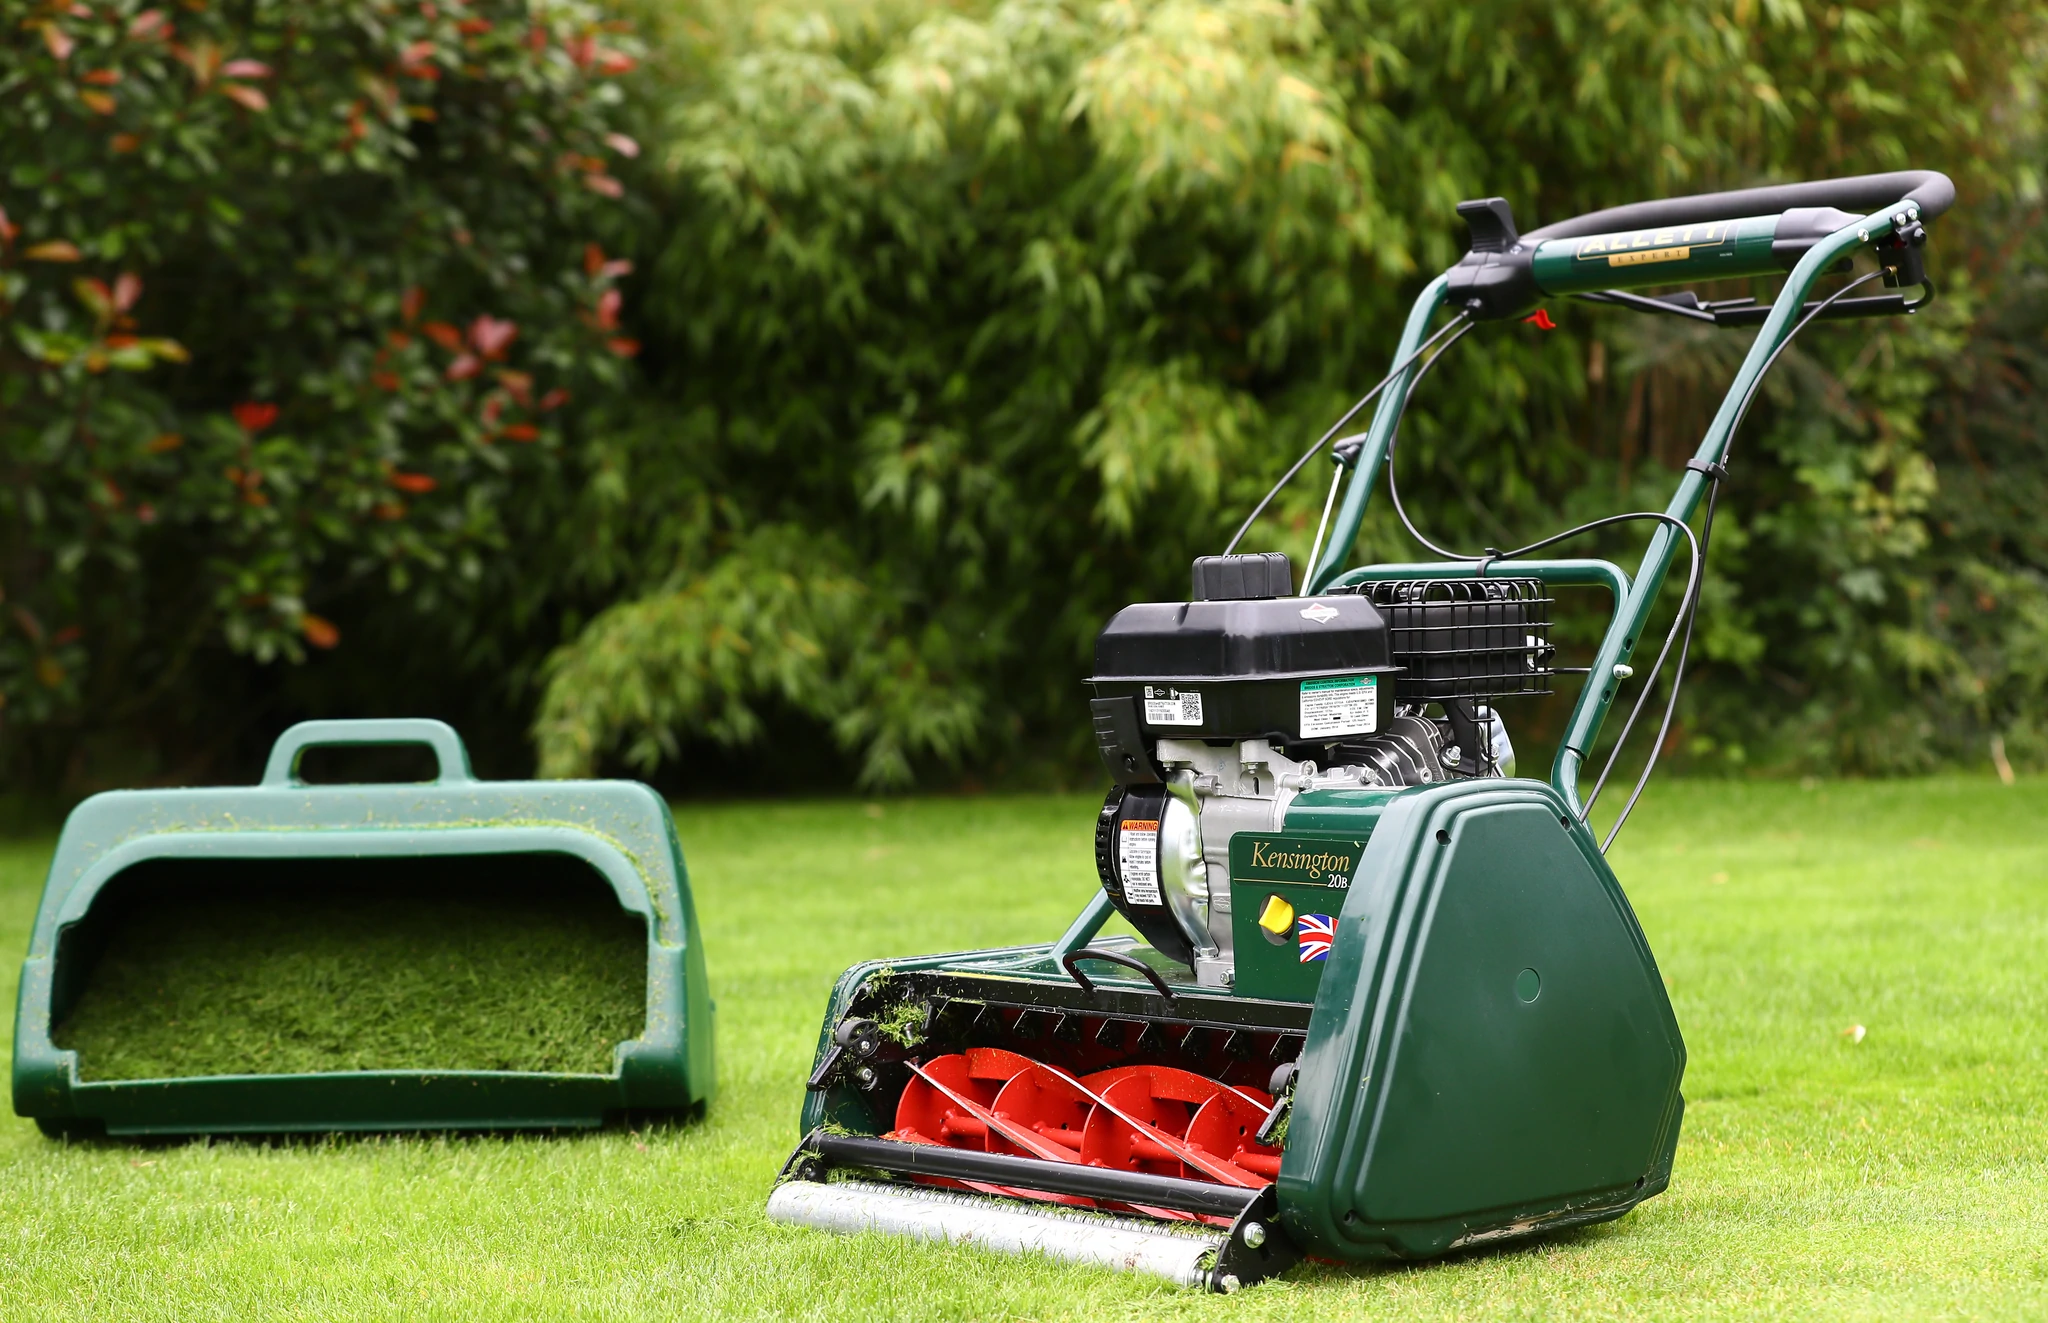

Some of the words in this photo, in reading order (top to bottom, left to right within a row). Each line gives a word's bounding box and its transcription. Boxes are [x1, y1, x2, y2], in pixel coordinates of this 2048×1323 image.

[1583, 224, 1724, 253] ALLETT
[1617, 250, 1682, 263] EXPERT
[1129, 821, 1158, 831] WARNING
[1251, 841, 1350, 879] Kensington
[1327, 873, 1348, 889] 20B
